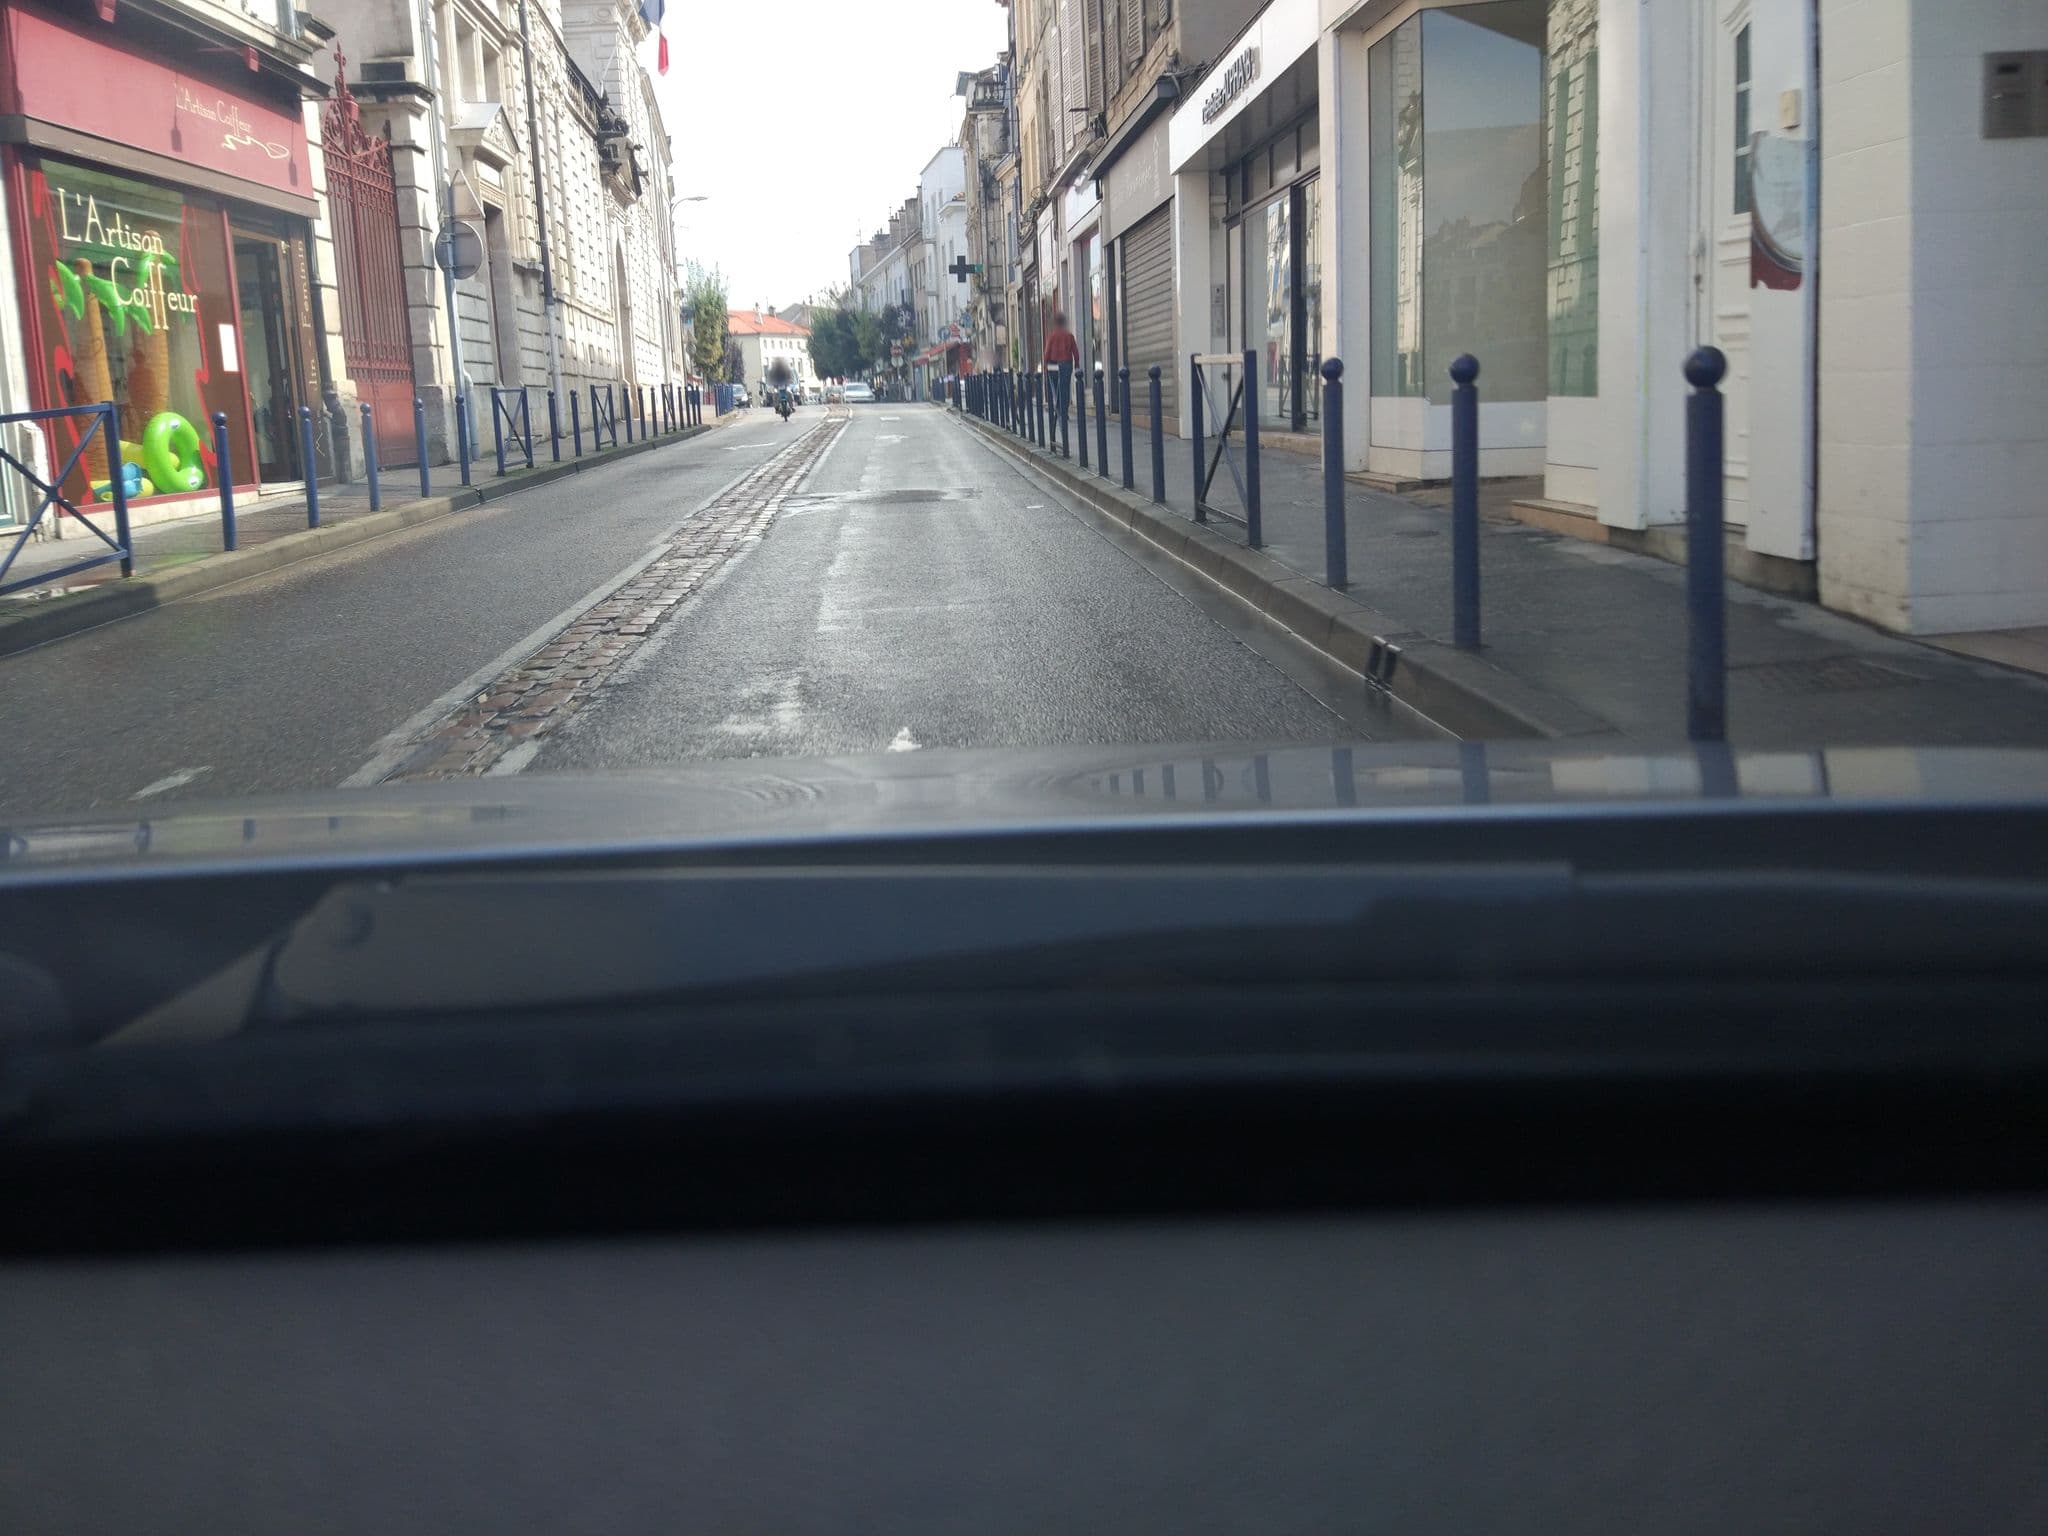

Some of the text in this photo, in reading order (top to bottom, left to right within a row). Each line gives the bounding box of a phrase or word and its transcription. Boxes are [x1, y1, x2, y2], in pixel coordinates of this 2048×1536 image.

[174, 85, 252, 137] L'Artisan Coiffeur
[110, 256, 198, 330] Coiffeur
